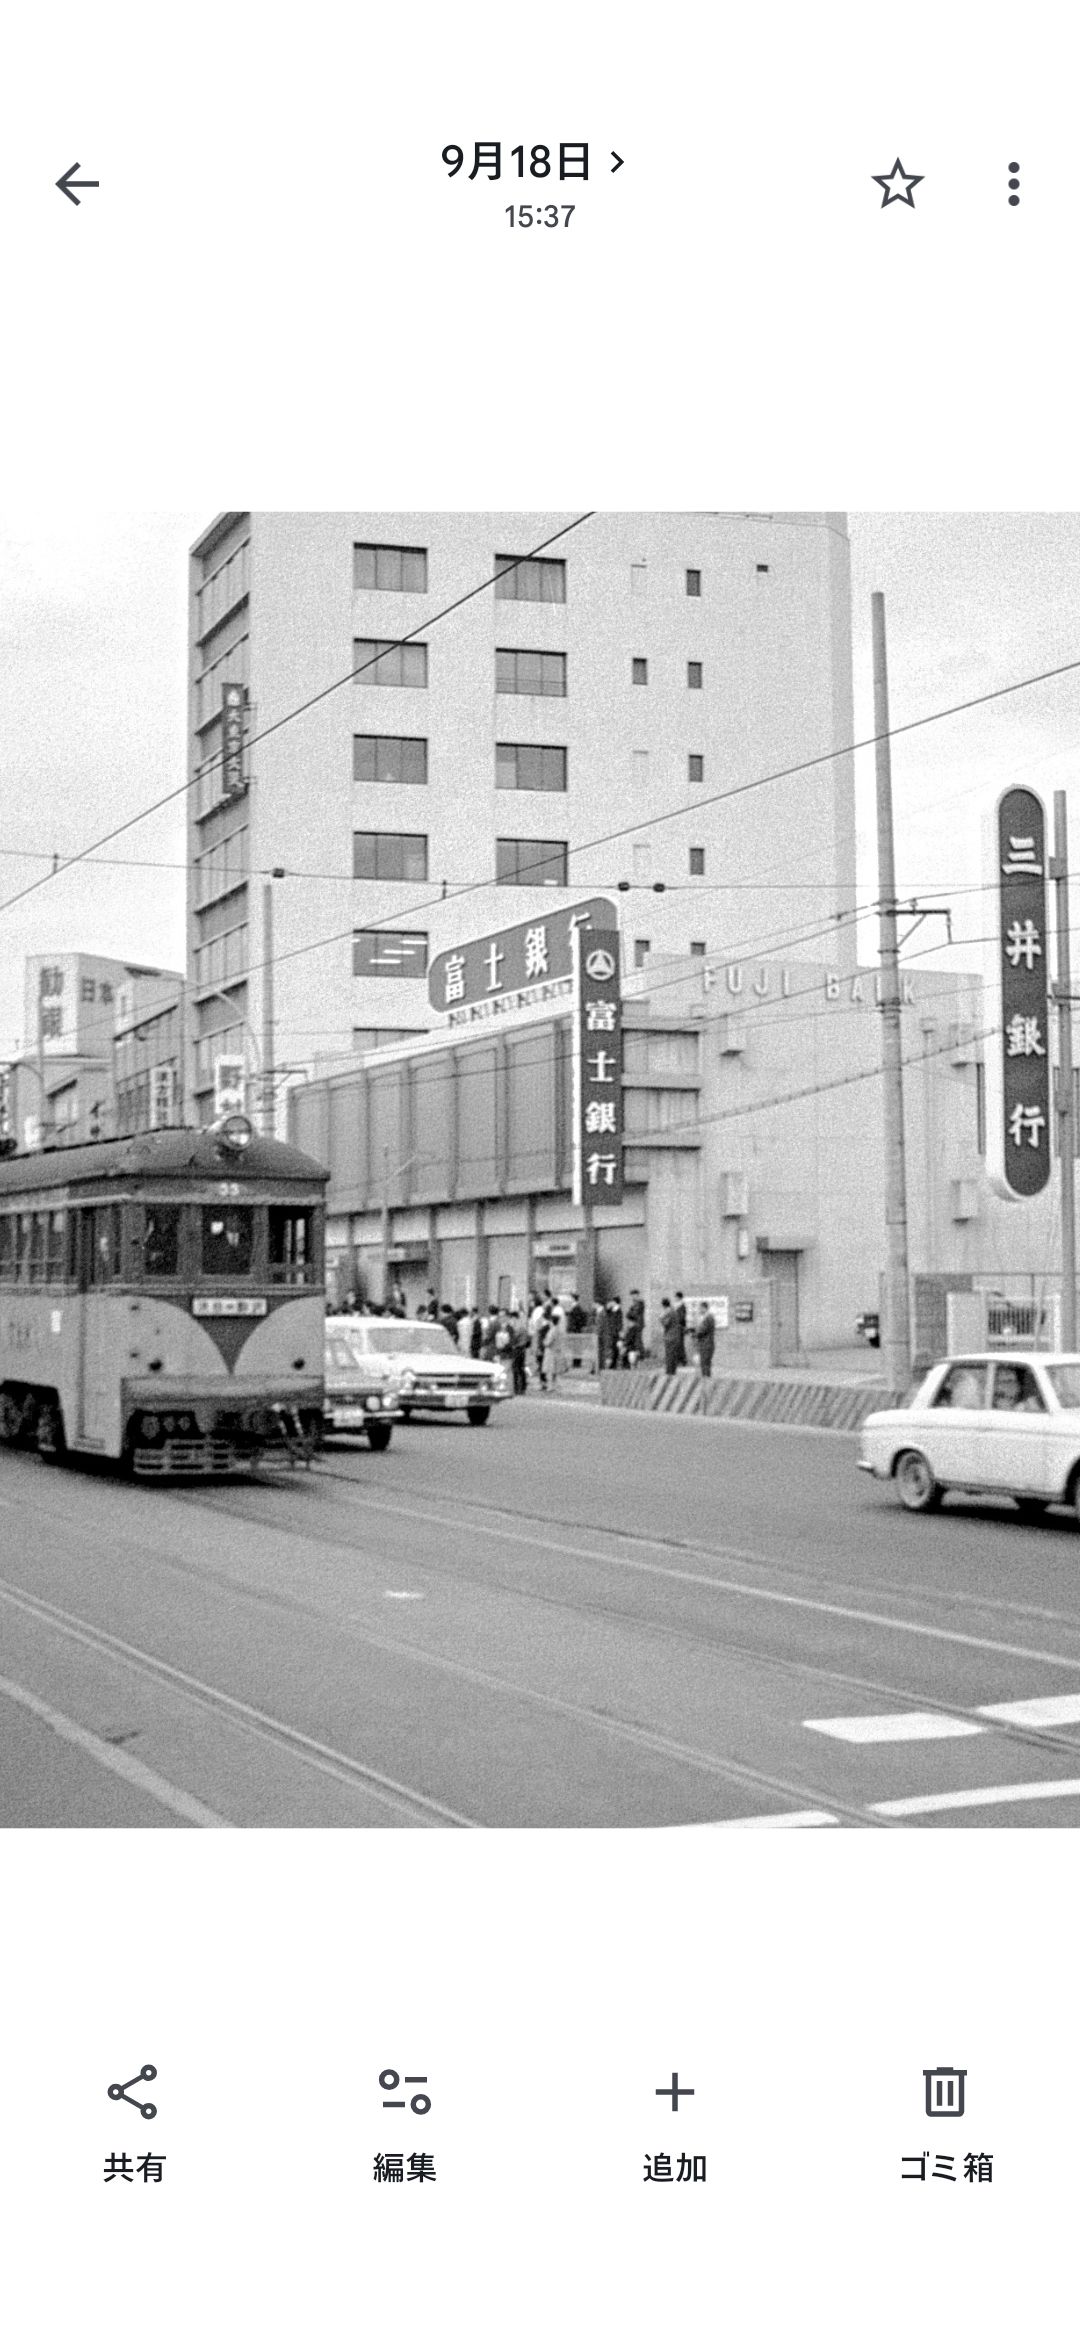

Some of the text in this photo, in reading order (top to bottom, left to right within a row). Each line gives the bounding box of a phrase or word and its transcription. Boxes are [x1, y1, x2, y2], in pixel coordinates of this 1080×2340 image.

[703, 965, 791, 998] FUJI
[1002, 836, 1046, 1148] 三井銀行
[585, 1000, 617, 1185] 富士銀行
